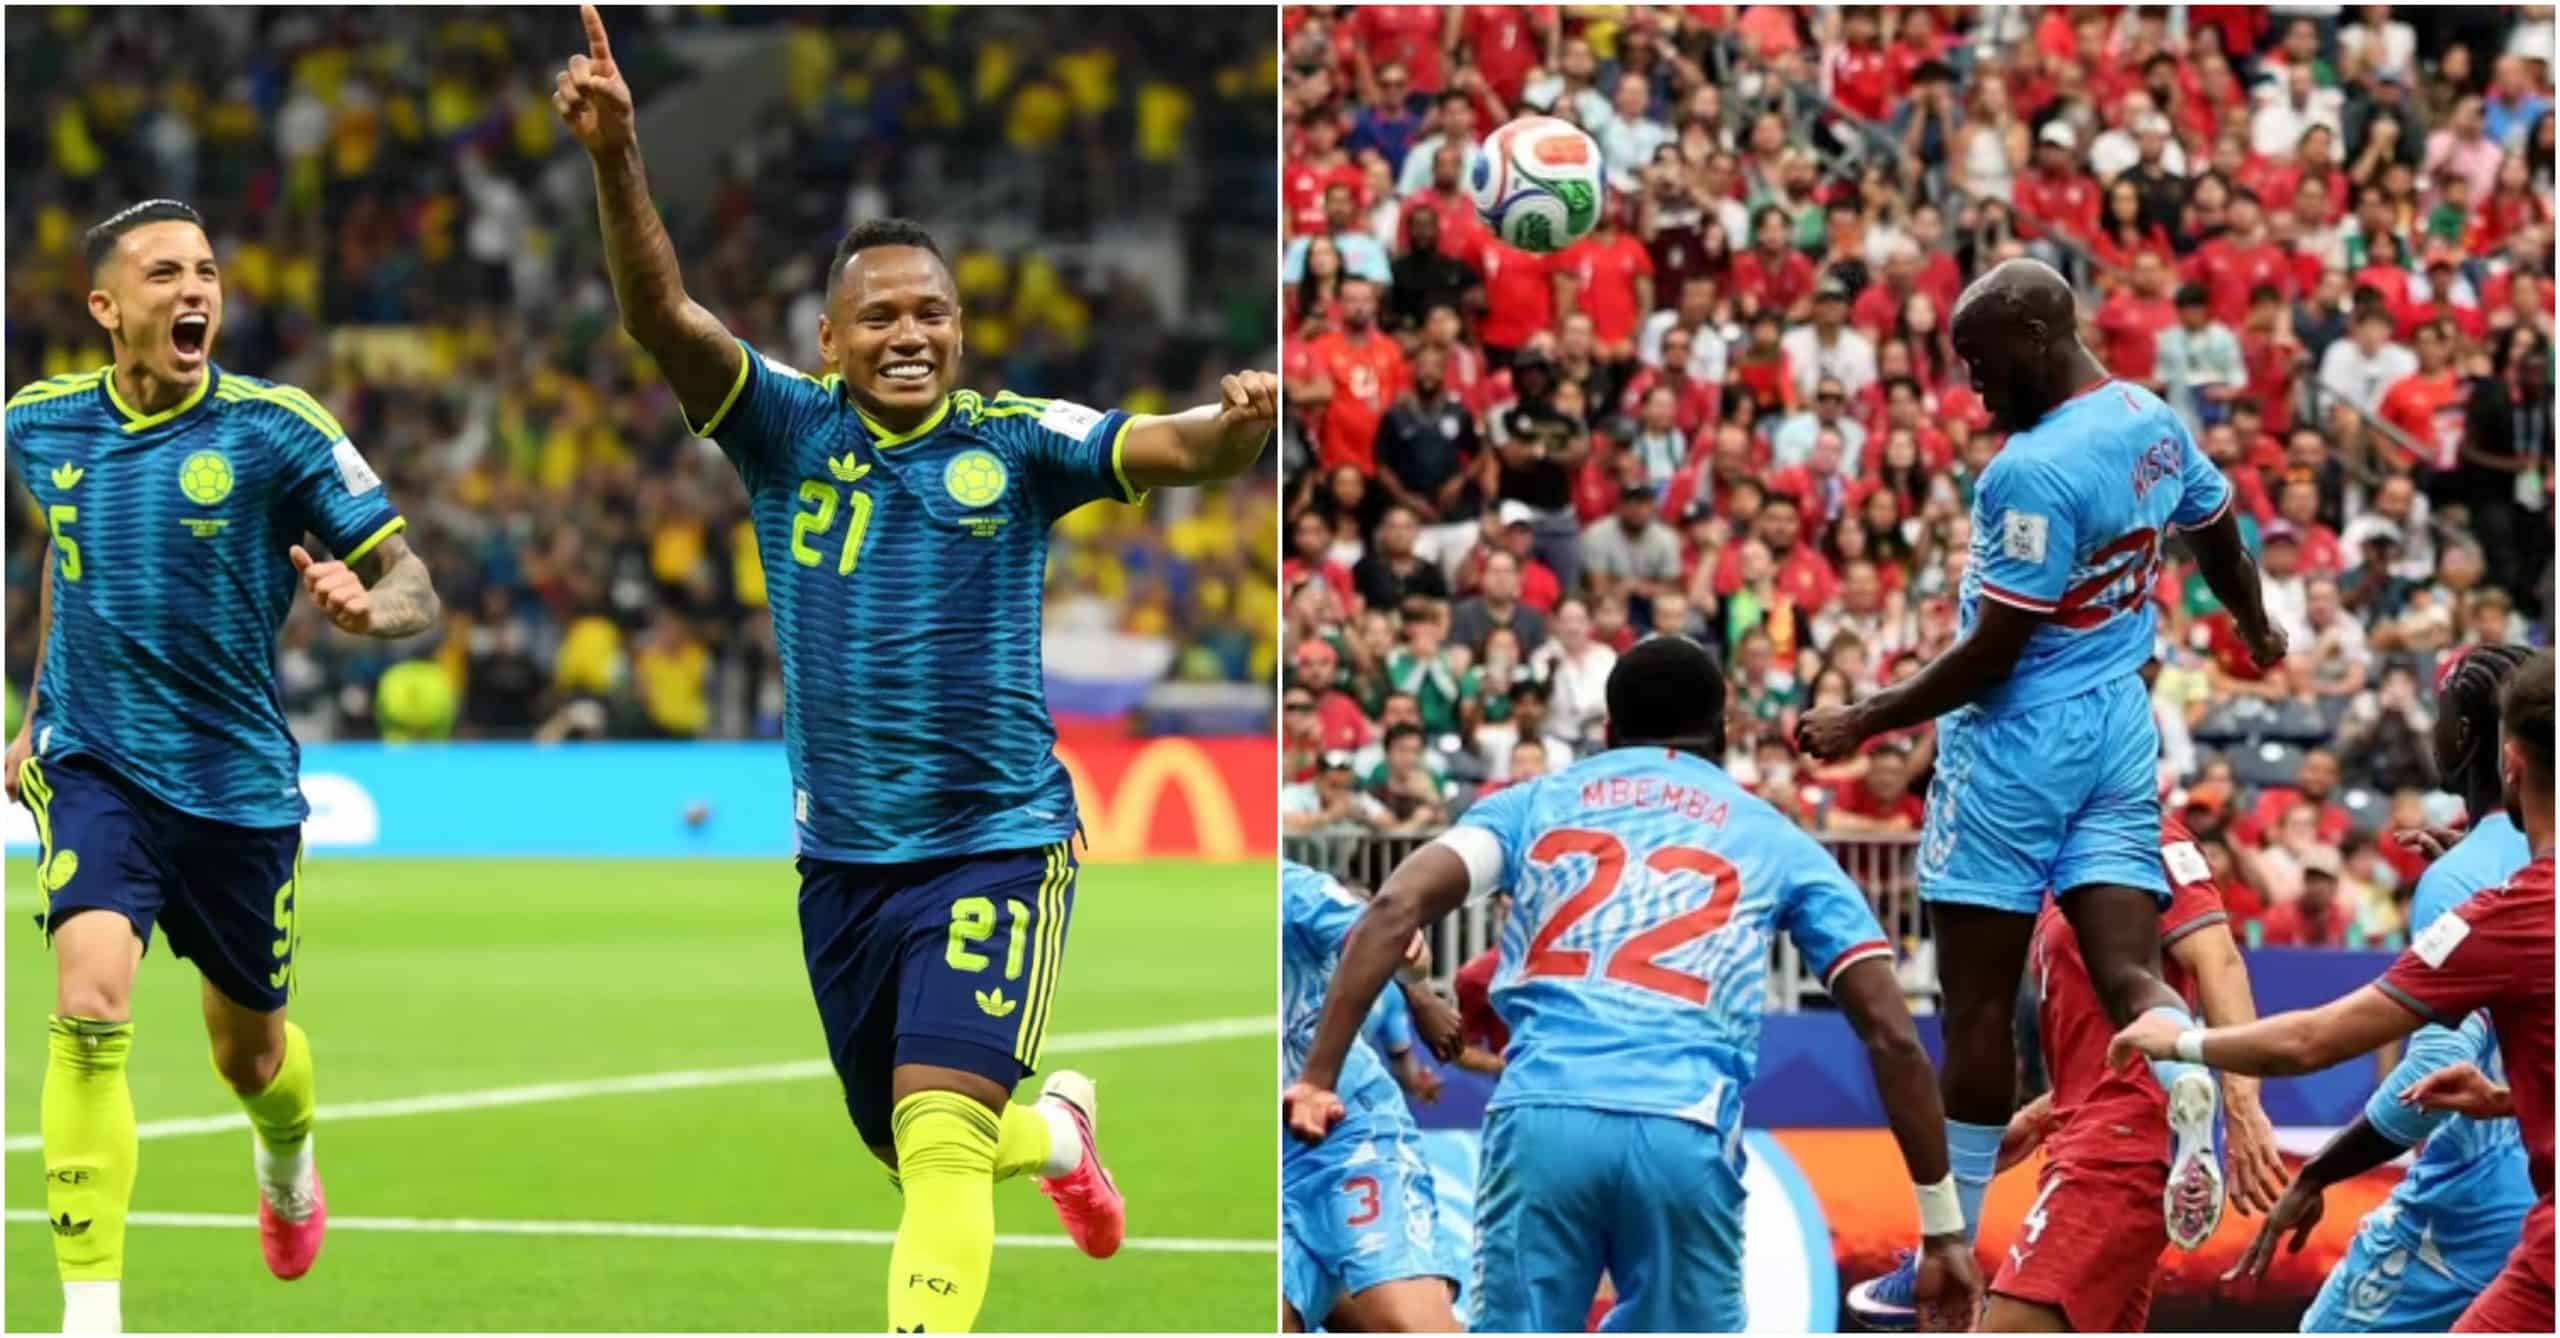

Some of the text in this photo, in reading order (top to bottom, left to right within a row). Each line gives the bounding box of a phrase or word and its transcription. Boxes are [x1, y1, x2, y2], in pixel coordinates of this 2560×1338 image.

[48, 505, 82, 581] 5
[791, 480, 873, 576] 21
[1582, 775, 1729, 829] MBEMBA
[944, 896, 1030, 980] 21
[1520, 827, 1741, 1006] 22
[1343, 1175, 1380, 1226] 3
[2023, 1170, 2063, 1244] 4
[908, 1273, 959, 1296] FCF
